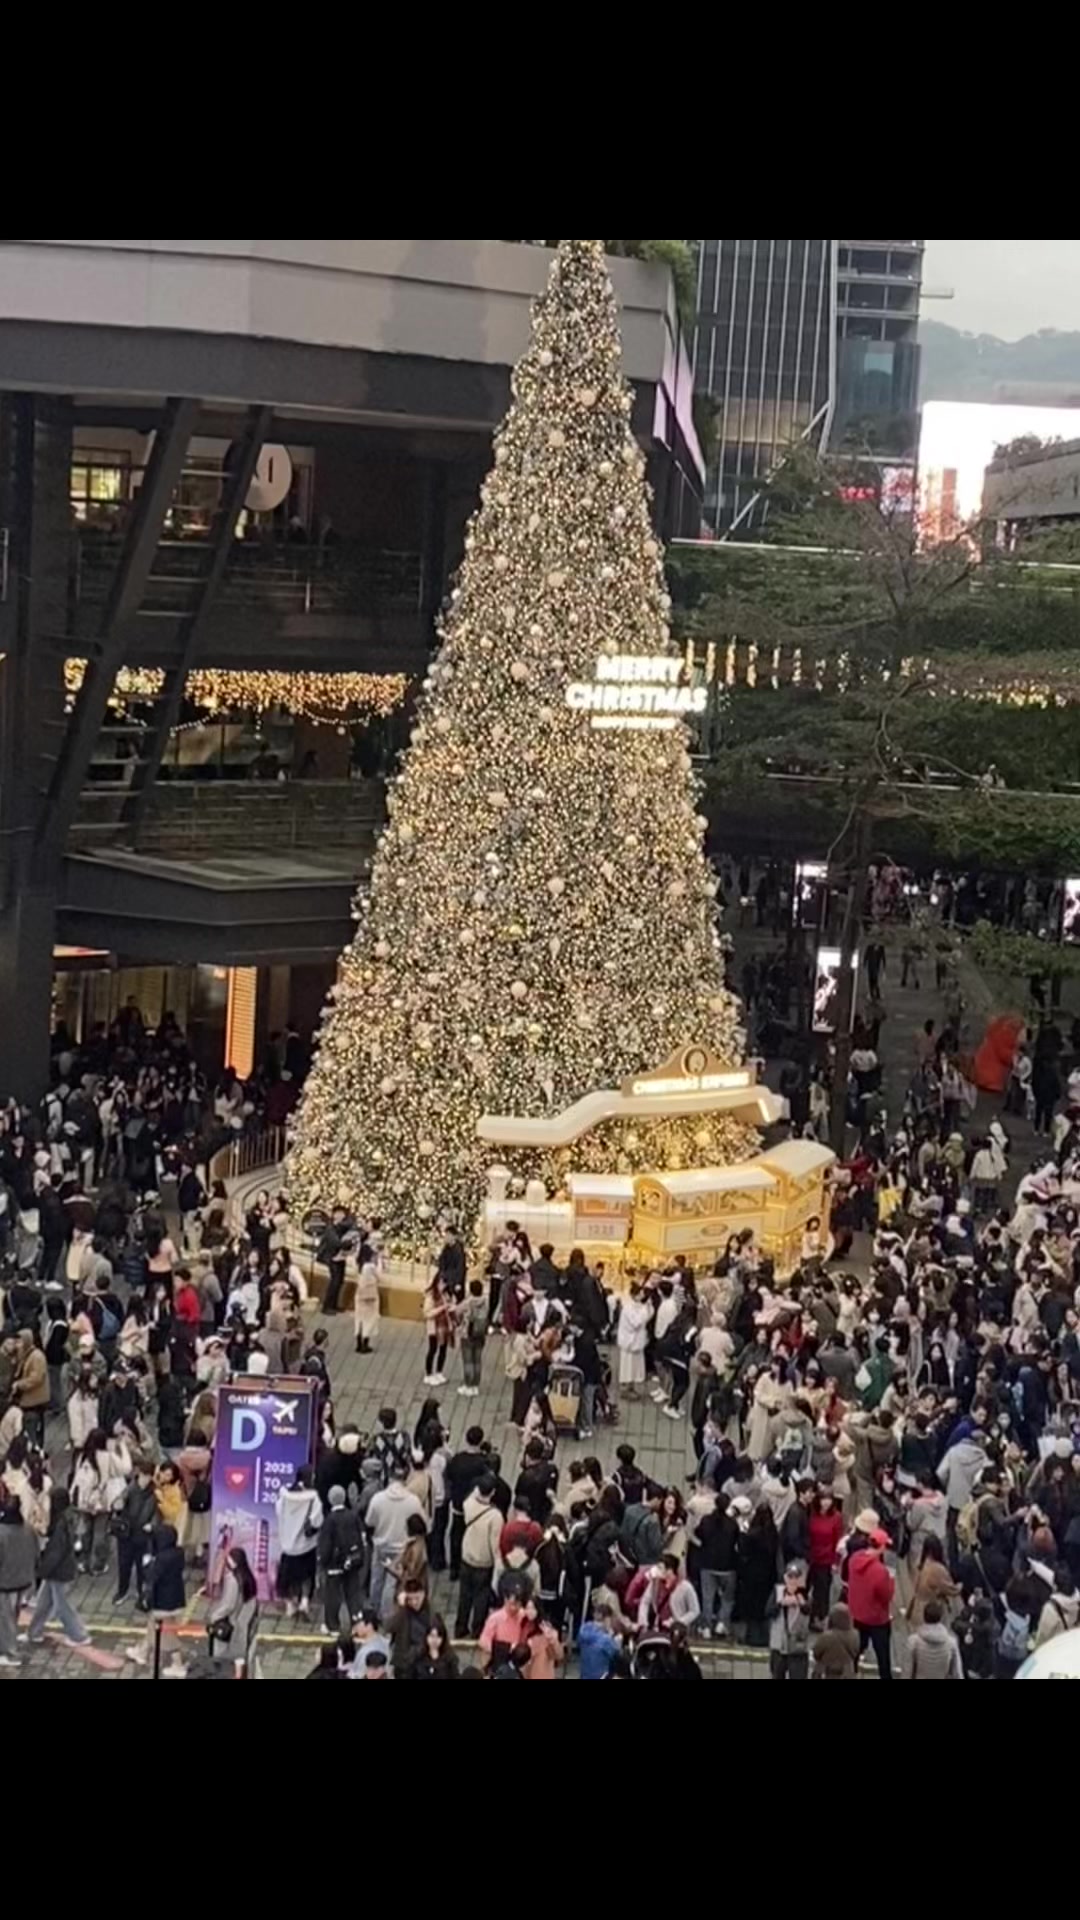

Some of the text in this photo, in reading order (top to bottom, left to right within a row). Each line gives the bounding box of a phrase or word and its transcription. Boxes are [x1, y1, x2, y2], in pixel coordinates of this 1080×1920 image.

[596, 655, 685, 684] MERRY
[565, 683, 708, 712] CHRISTMAS
[231, 1408, 266, 1451] D
[264, 1461, 294, 1474] 2025
[263, 1477, 281, 1489] TO
